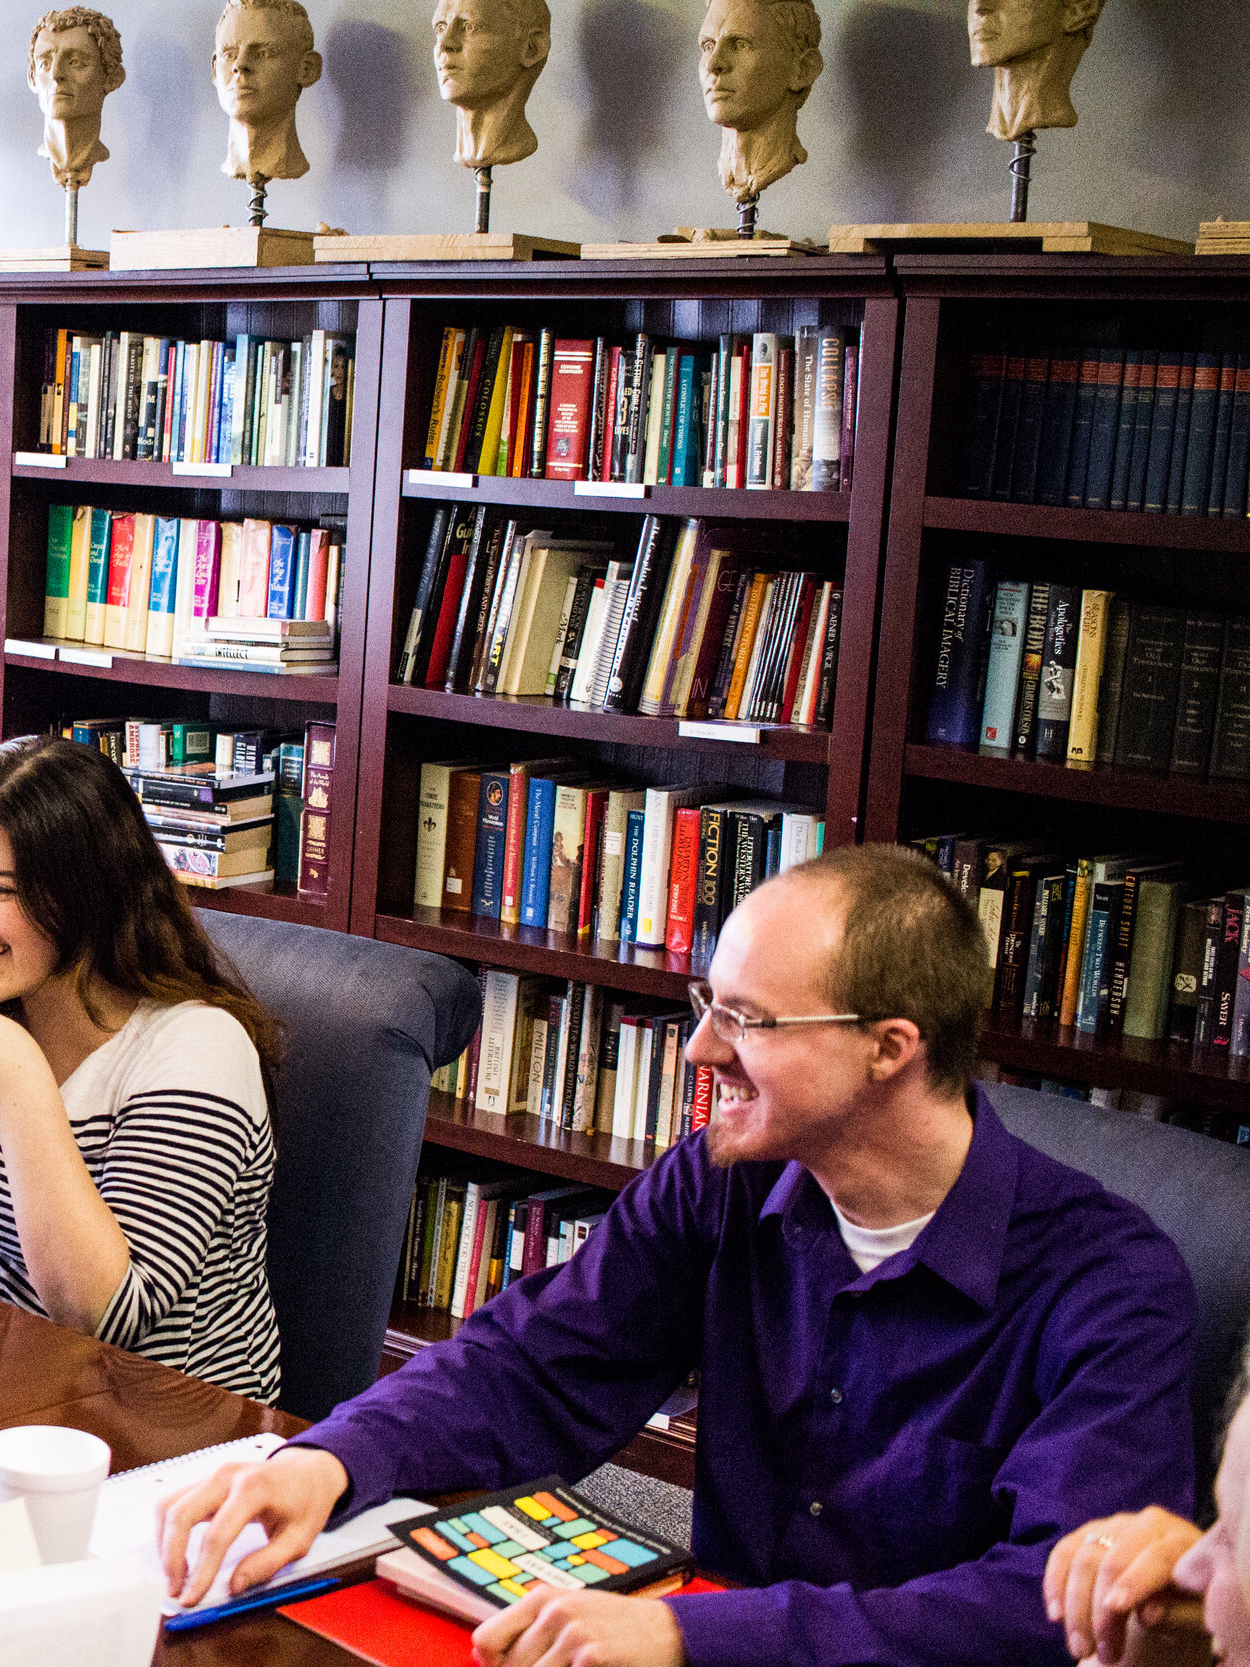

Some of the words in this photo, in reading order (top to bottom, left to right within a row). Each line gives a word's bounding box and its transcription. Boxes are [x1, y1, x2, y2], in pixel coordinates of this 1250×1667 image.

[635, 341, 645, 358] STOP
[804, 354, 813, 372] The
[632, 359, 643, 387] SETTING
[759, 368, 769, 378] The
[759, 378, 768, 392] World
[803, 373, 812, 396] State
[820, 337, 840, 410] COLLAPSE
[432, 374, 446, 415] Robert's
[474, 379, 492, 437] COLOSSUS
[630, 389, 642, 411] GOALS
[758, 402, 767, 415] Flat
[427, 419, 439, 445] Rules
[800, 410, 810, 456] Humanity
[496, 552, 520, 628] MODERN
[943, 567, 961, 626] BIBLICAL
[956, 568, 975, 629] Dictionary
[1030, 583, 1049, 613] THE
[555, 613, 569, 645] Mark
[744, 603, 757, 632] HYMN
[1025, 614, 1047, 653] BODY
[1054, 600, 1070, 655] Apologetics
[1082, 616, 1091, 633] LIFE
[1089, 602, 1100, 638] SEASONS
[491, 632, 503, 667] ART
[736, 633, 750, 669] STORIES
[955, 630, 964, 642] of
[215, 647, 248, 659] INTELLECT
[936, 628, 954, 689] IMAGERY
[1024, 680, 1035, 709] CHARLES
[630, 838, 639, 879] DOLPHIN
[705, 812, 721, 876] FICTION
[506, 852, 515, 888] Economics
[745, 836, 754, 888] LITERATURE
[626, 882, 636, 919] READER
[703, 880, 717, 906] 100
[1122, 876, 1136, 916] CULTURE
[1095, 919, 1106, 951] BETWEEN
[1118, 920, 1131, 948] SHIFT
[1224, 903, 1244, 945] JACK
[1240, 922, 1250, 954] Society
[1094, 952, 1103, 968] TWO
[1091, 970, 1101, 998] WORLDS
[1109, 962, 1125, 1015] HENDERSON
[1219, 991, 1231, 1026] SAYER
[486, 1037, 495, 1081] LITERATURE
[532, 1030, 545, 1083] MILTON
[568, 1044, 577, 1070] WORLD
[463, 1213, 474, 1240] PLACE
[460, 1242, 471, 1258] FOR
[457, 1260, 469, 1288] TRUTH
